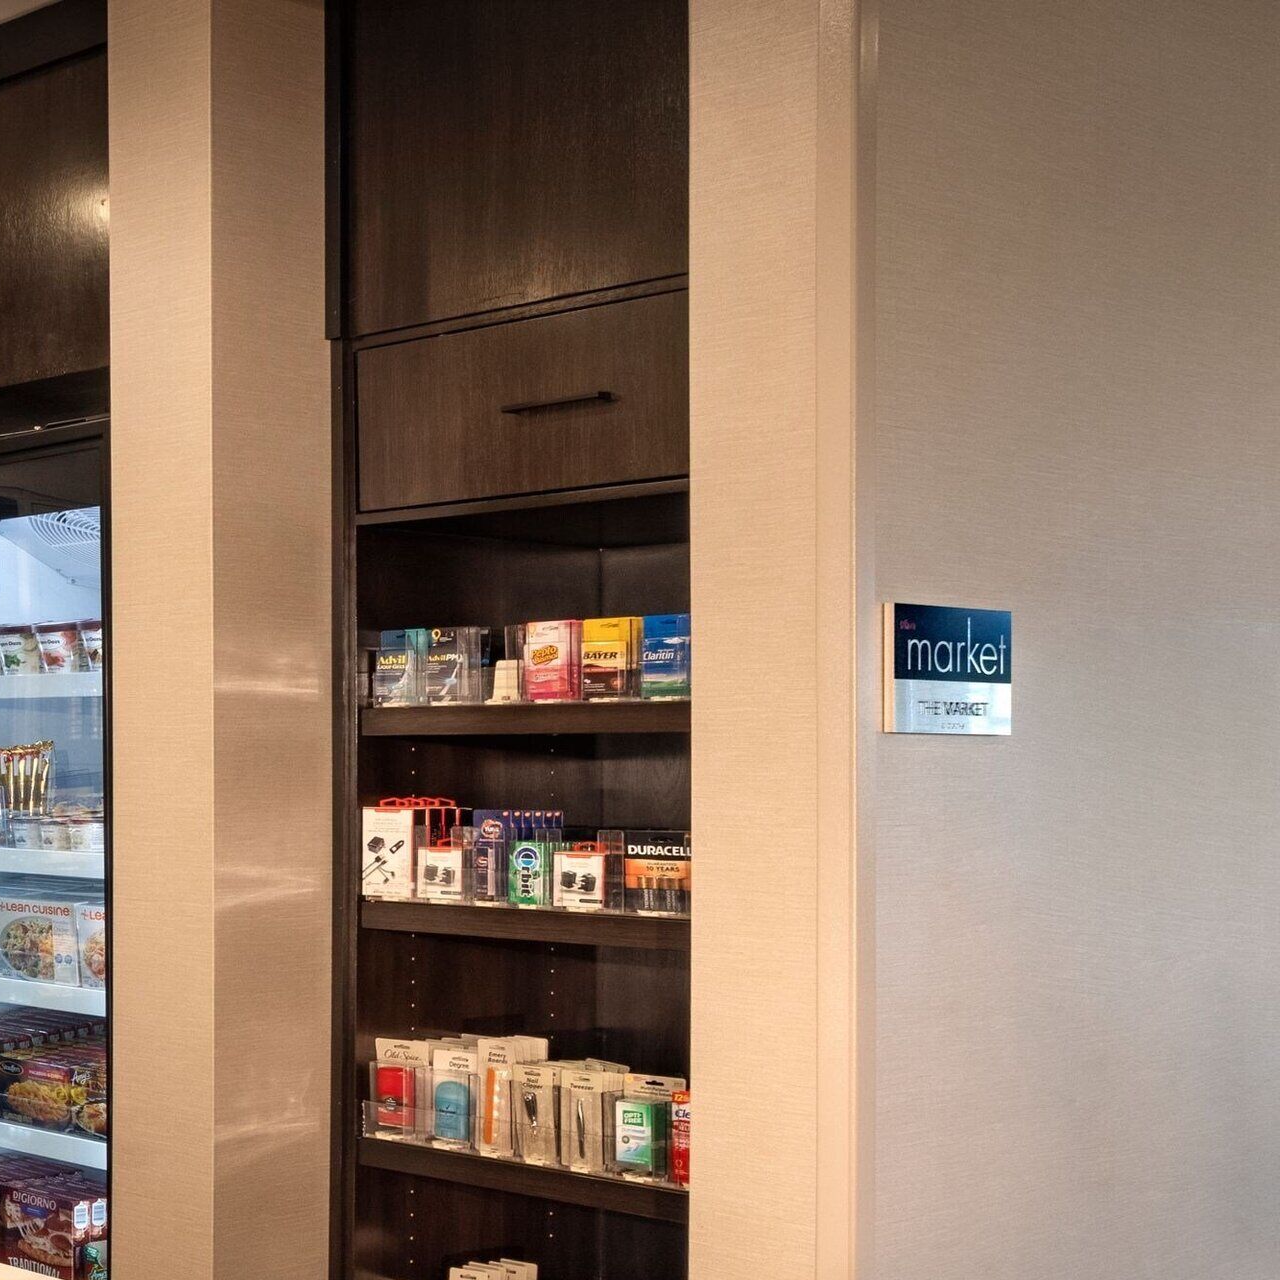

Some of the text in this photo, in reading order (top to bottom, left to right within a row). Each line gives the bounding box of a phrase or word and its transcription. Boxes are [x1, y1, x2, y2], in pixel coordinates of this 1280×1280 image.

[907, 617, 1006, 675] market
[583, 651, 618, 660] BAYER
[643, 651, 674, 661] Claritin
[918, 700, 989, 716] THE MARKET
[627, 845, 691, 857] DURACELL
[5, 902, 70, 917] Lean cuisine
[570, 1082, 594, 1091] Tweezer
[13, 1191, 56, 1210] DIGIORNO
